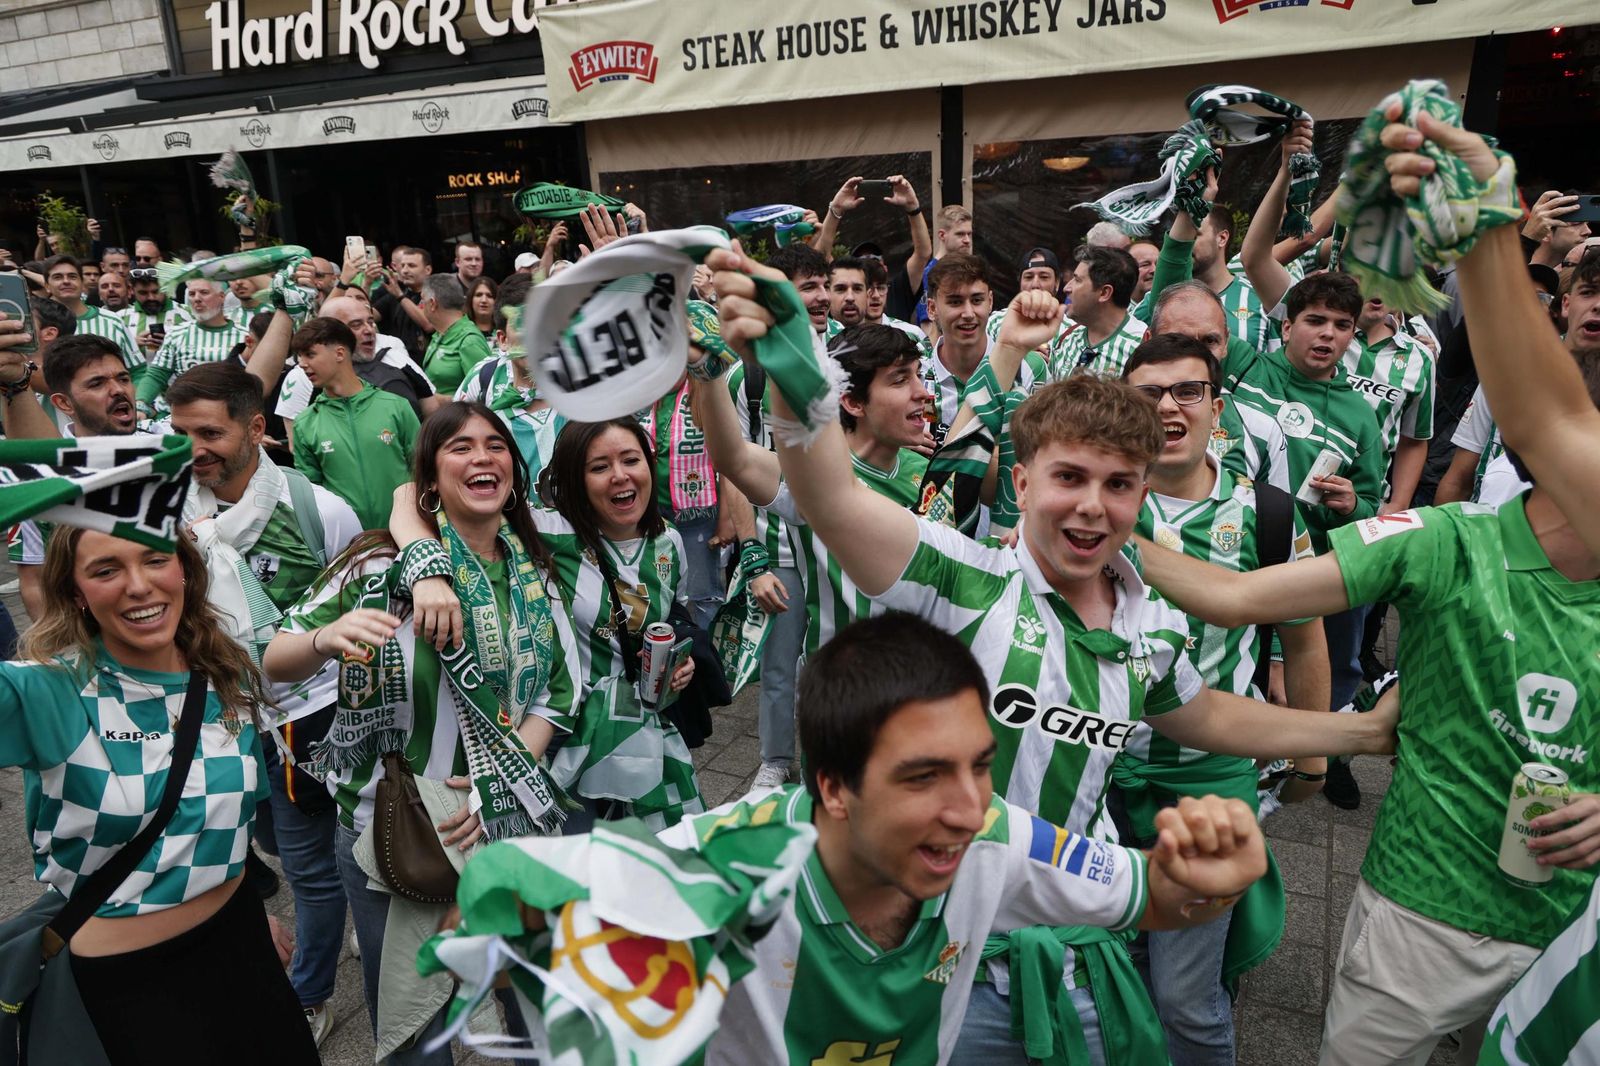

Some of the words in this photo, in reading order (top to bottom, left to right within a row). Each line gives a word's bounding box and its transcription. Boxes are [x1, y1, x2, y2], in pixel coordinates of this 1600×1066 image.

[205, 0, 324, 71] Hard
[338, 0, 466, 69] Rock
[474, 0, 546, 37] Ca
[578, 45, 648, 77] ŻYWIEC
[682, 28, 767, 72] STEAK
[776, 15, 867, 62] HOUSE
[879, 13, 899, 49] &
[911, 0, 1059, 47] WHISKEY
[1076, 0, 1168, 29] JARS
[448, 172, 484, 188] ROCK
[482, 608, 504, 668] DRAPS
